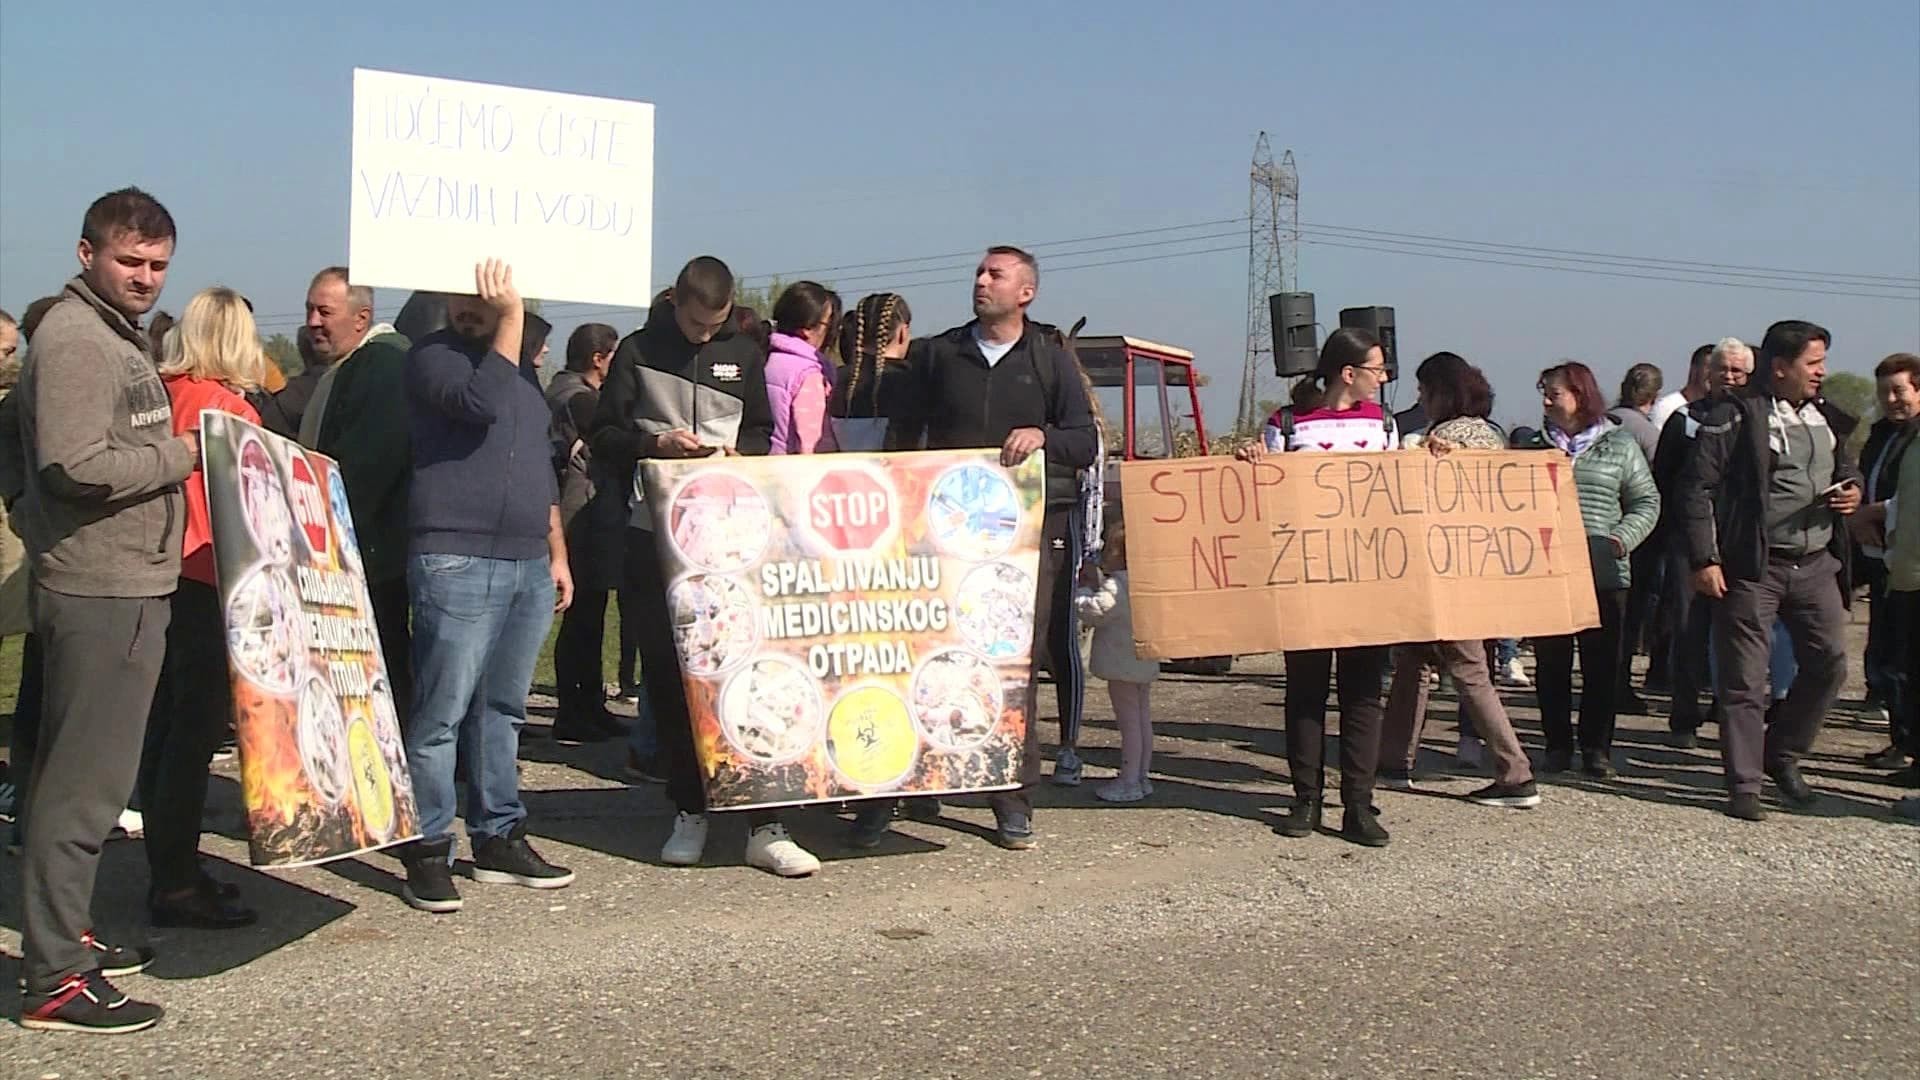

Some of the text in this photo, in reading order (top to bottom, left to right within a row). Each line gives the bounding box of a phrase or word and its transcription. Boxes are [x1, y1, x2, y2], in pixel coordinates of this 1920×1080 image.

[535, 191, 634, 236] VODU
[811, 490, 886, 529] STOP
[1150, 463, 1285, 525] STOP
[761, 556, 940, 596] SPALJIVANJU
[1191, 523, 1553, 590] NE ŽELIMO OTPAD!
[762, 598, 948, 639] MEDICINSKOG
[808, 642, 912, 678] OTPADA
